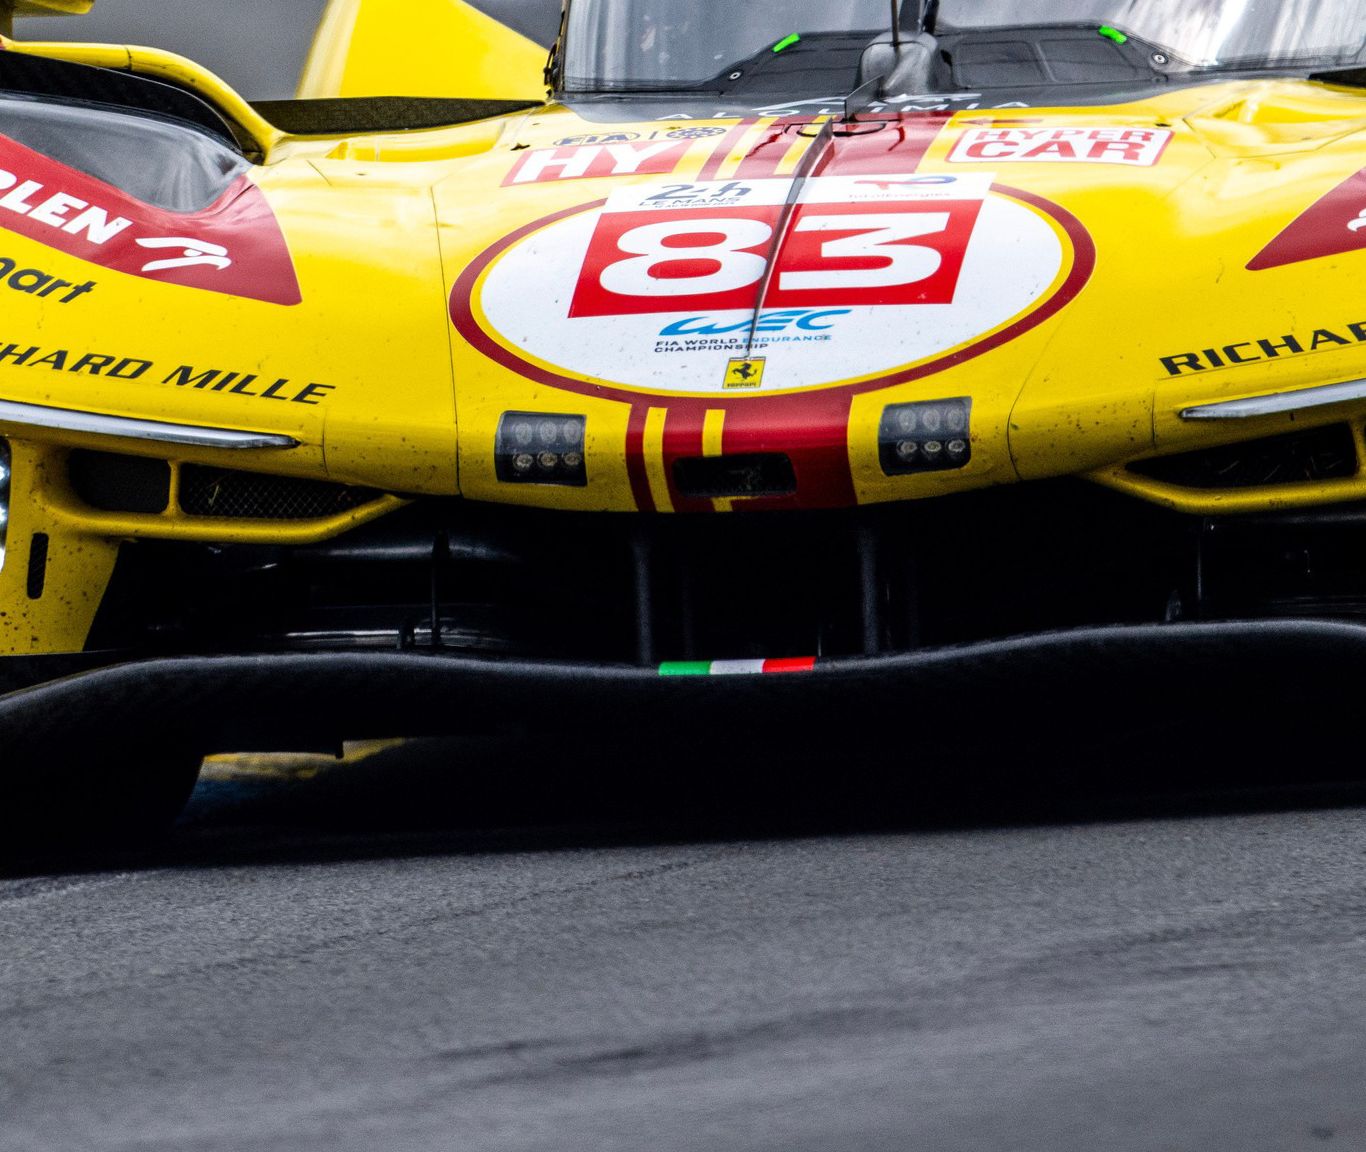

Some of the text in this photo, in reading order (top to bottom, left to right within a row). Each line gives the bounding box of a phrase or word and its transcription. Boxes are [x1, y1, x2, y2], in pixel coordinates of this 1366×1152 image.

[560, 132, 633, 146] FIA
[975, 129, 1156, 143] HYPER
[512, 141, 685, 184] HY
[965, 140, 1147, 161] CAR
[599, 212, 949, 298] 83
[658, 309, 853, 336] WEC
[685, 337, 738, 346] WORLD
[742, 334, 832, 345] ENDURANCE
[162, 365, 337, 405] MILLE
